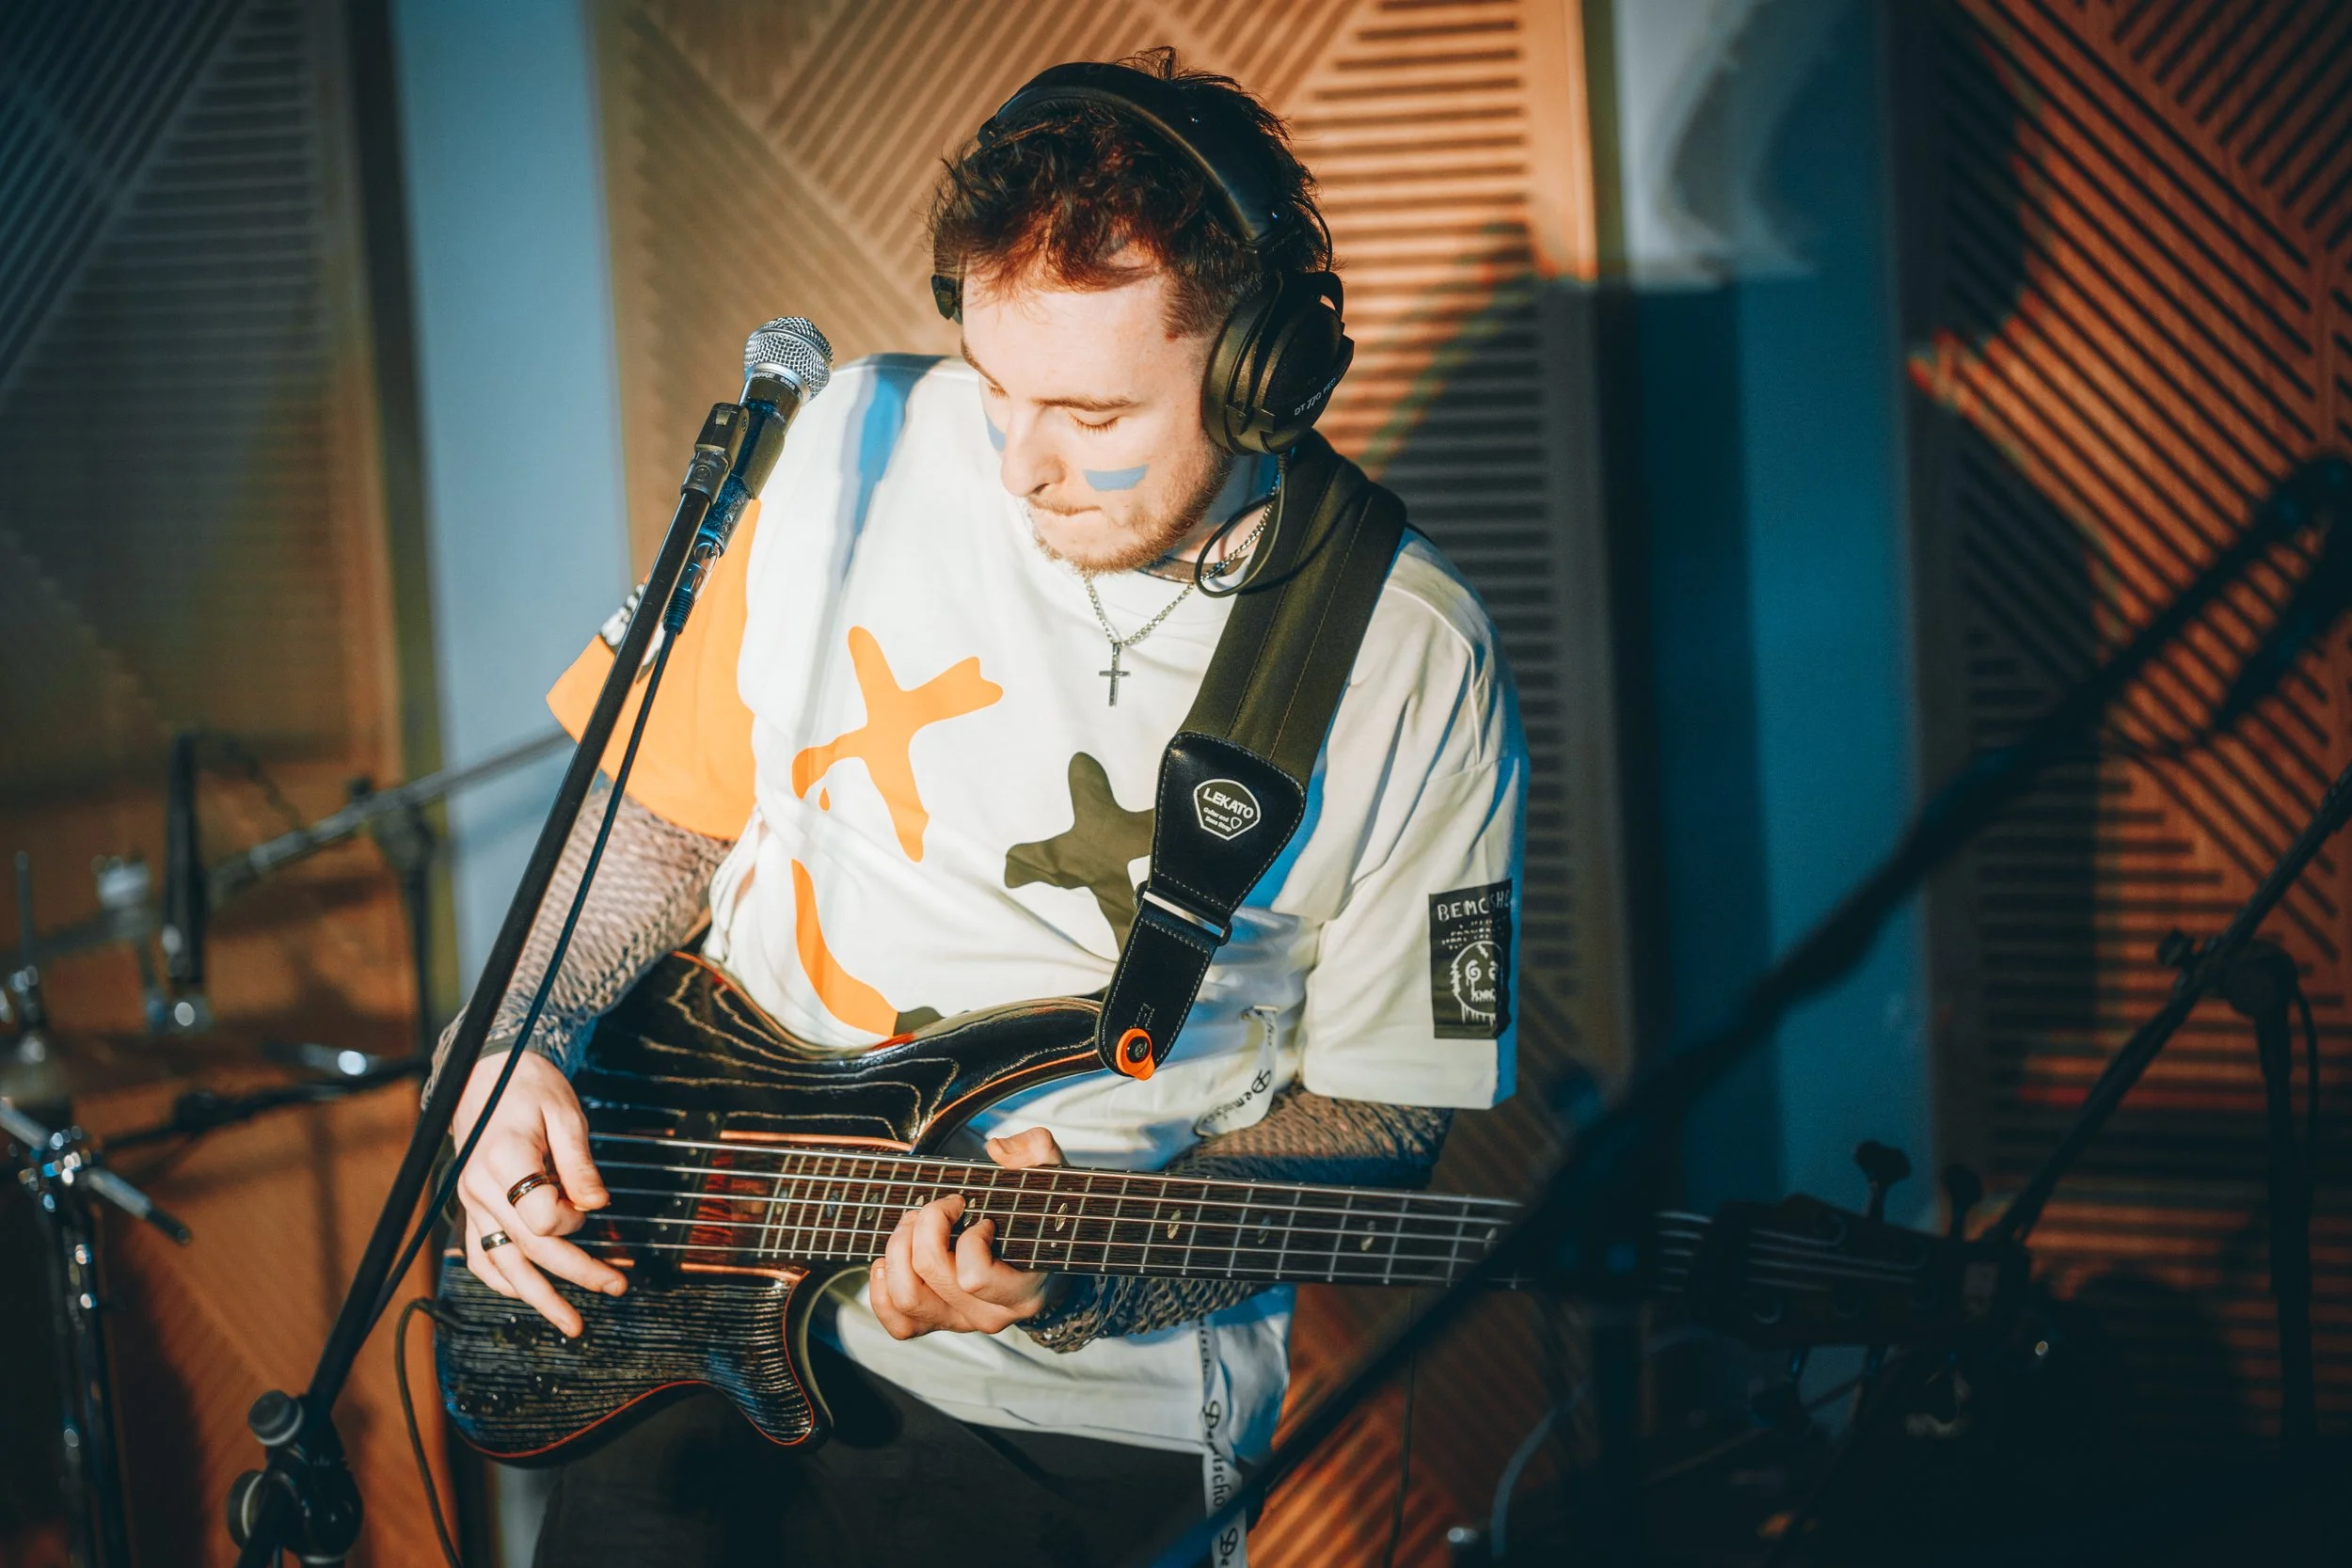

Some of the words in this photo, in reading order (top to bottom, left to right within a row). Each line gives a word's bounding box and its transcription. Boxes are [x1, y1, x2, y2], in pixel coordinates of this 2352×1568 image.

[1295, 403, 1306, 416] DT
[1307, 391, 1322, 409] 770
[1323, 377, 1337, 394] PRO
[1202, 786, 1255, 819] LEKATO
